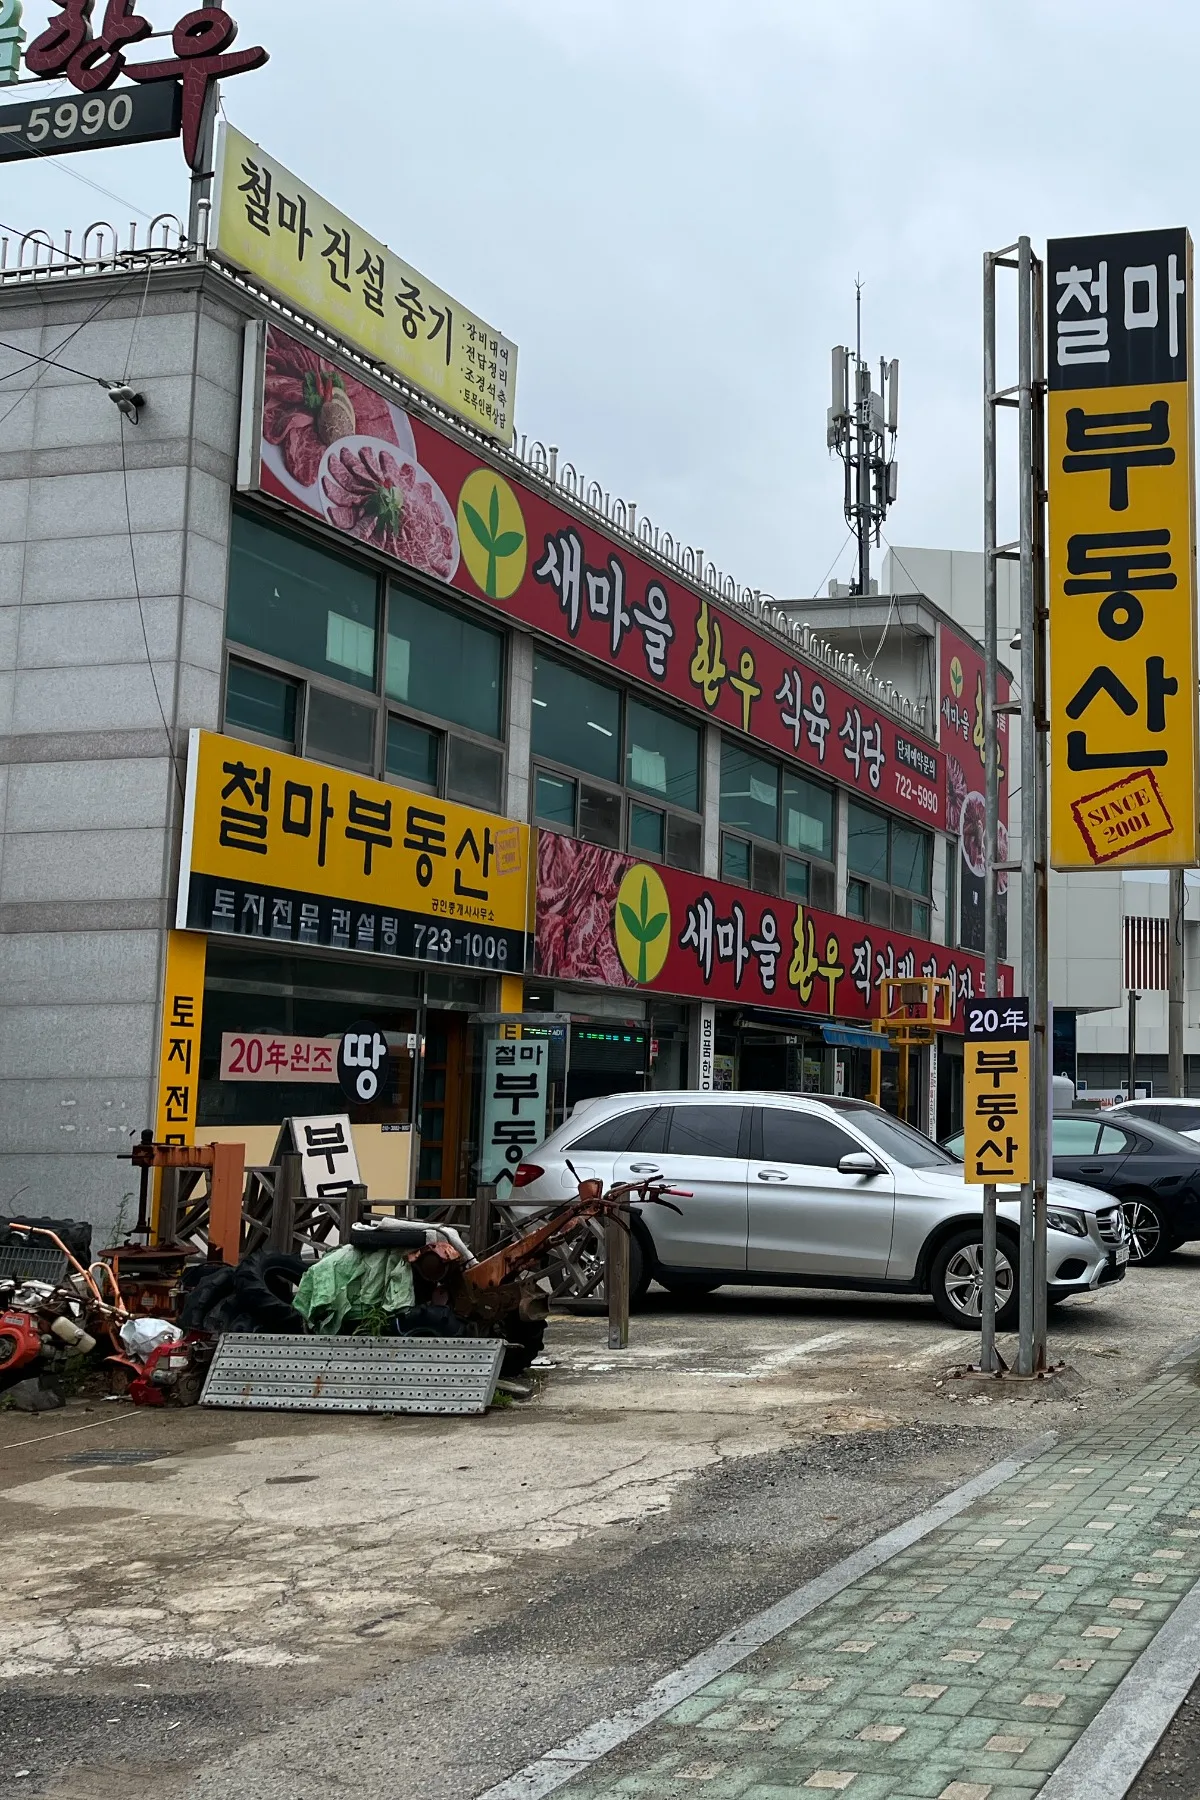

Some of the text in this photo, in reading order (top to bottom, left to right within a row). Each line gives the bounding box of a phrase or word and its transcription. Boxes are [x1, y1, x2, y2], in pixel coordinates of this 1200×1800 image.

[237, 157, 452, 366] 철마 건설 중기
[1056, 253, 1185, 366] 철마
[1062, 400, 1177, 771] 부동산
[536, 533, 885, 789] 새마을 한우 식육 식당
[895, 772, 938, 814] 722-5990
[897, 739, 936, 780] 단체예약문의
[219, 761, 495, 901] 철마부동산
[1087, 788, 1151, 827] SINCE
[1103, 812, 1152, 843] 2001
[211, 889, 508, 961] 토지전문 컨설팅 723-1006
[431, 898, 495, 922] 공인중개사사무소
[681, 897, 781, 989] 새마을
[789, 905, 844, 1016] 한우
[495, 1045, 544, 1066] 철마
[969, 1007, 1028, 1034] 20年
[343, 1032, 387, 1100] 땅
[975, 1049, 1019, 1176] 부동산
